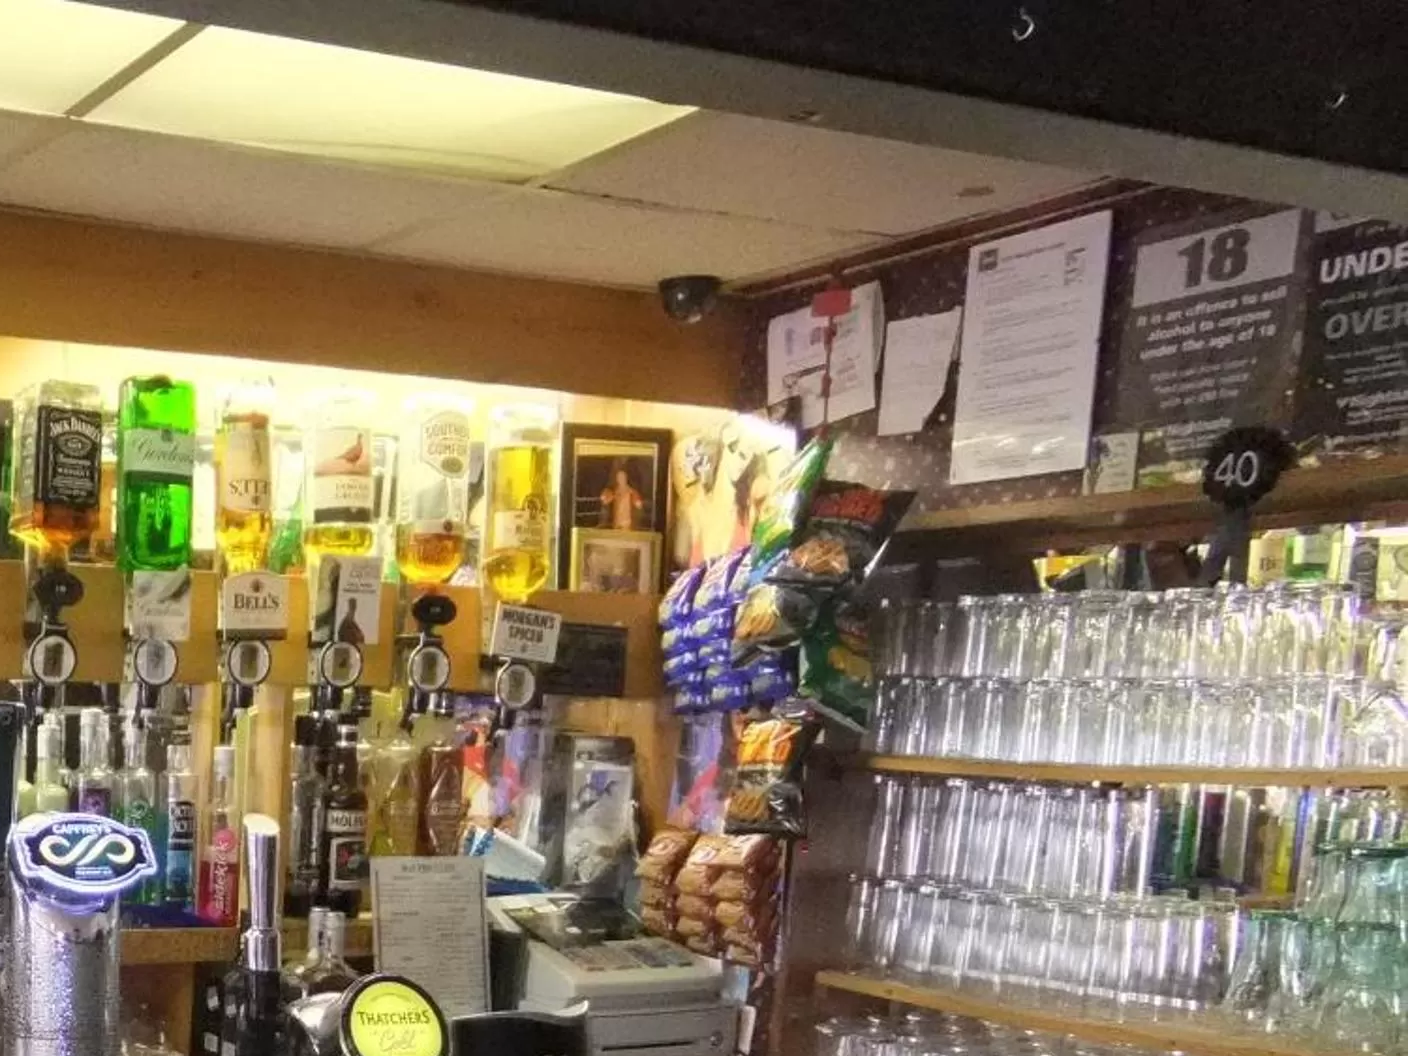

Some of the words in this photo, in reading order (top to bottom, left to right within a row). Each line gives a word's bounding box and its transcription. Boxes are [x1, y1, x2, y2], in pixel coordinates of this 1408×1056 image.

[1179, 228, 1251, 288] 18
[1320, 240, 1408, 284] UNDE
[1147, 320, 1197, 341] alcohol
[1214, 450, 1259, 487] 40
[233, 591, 280, 611] BELL'S
[356, 1009, 431, 1027] THATCHERS
